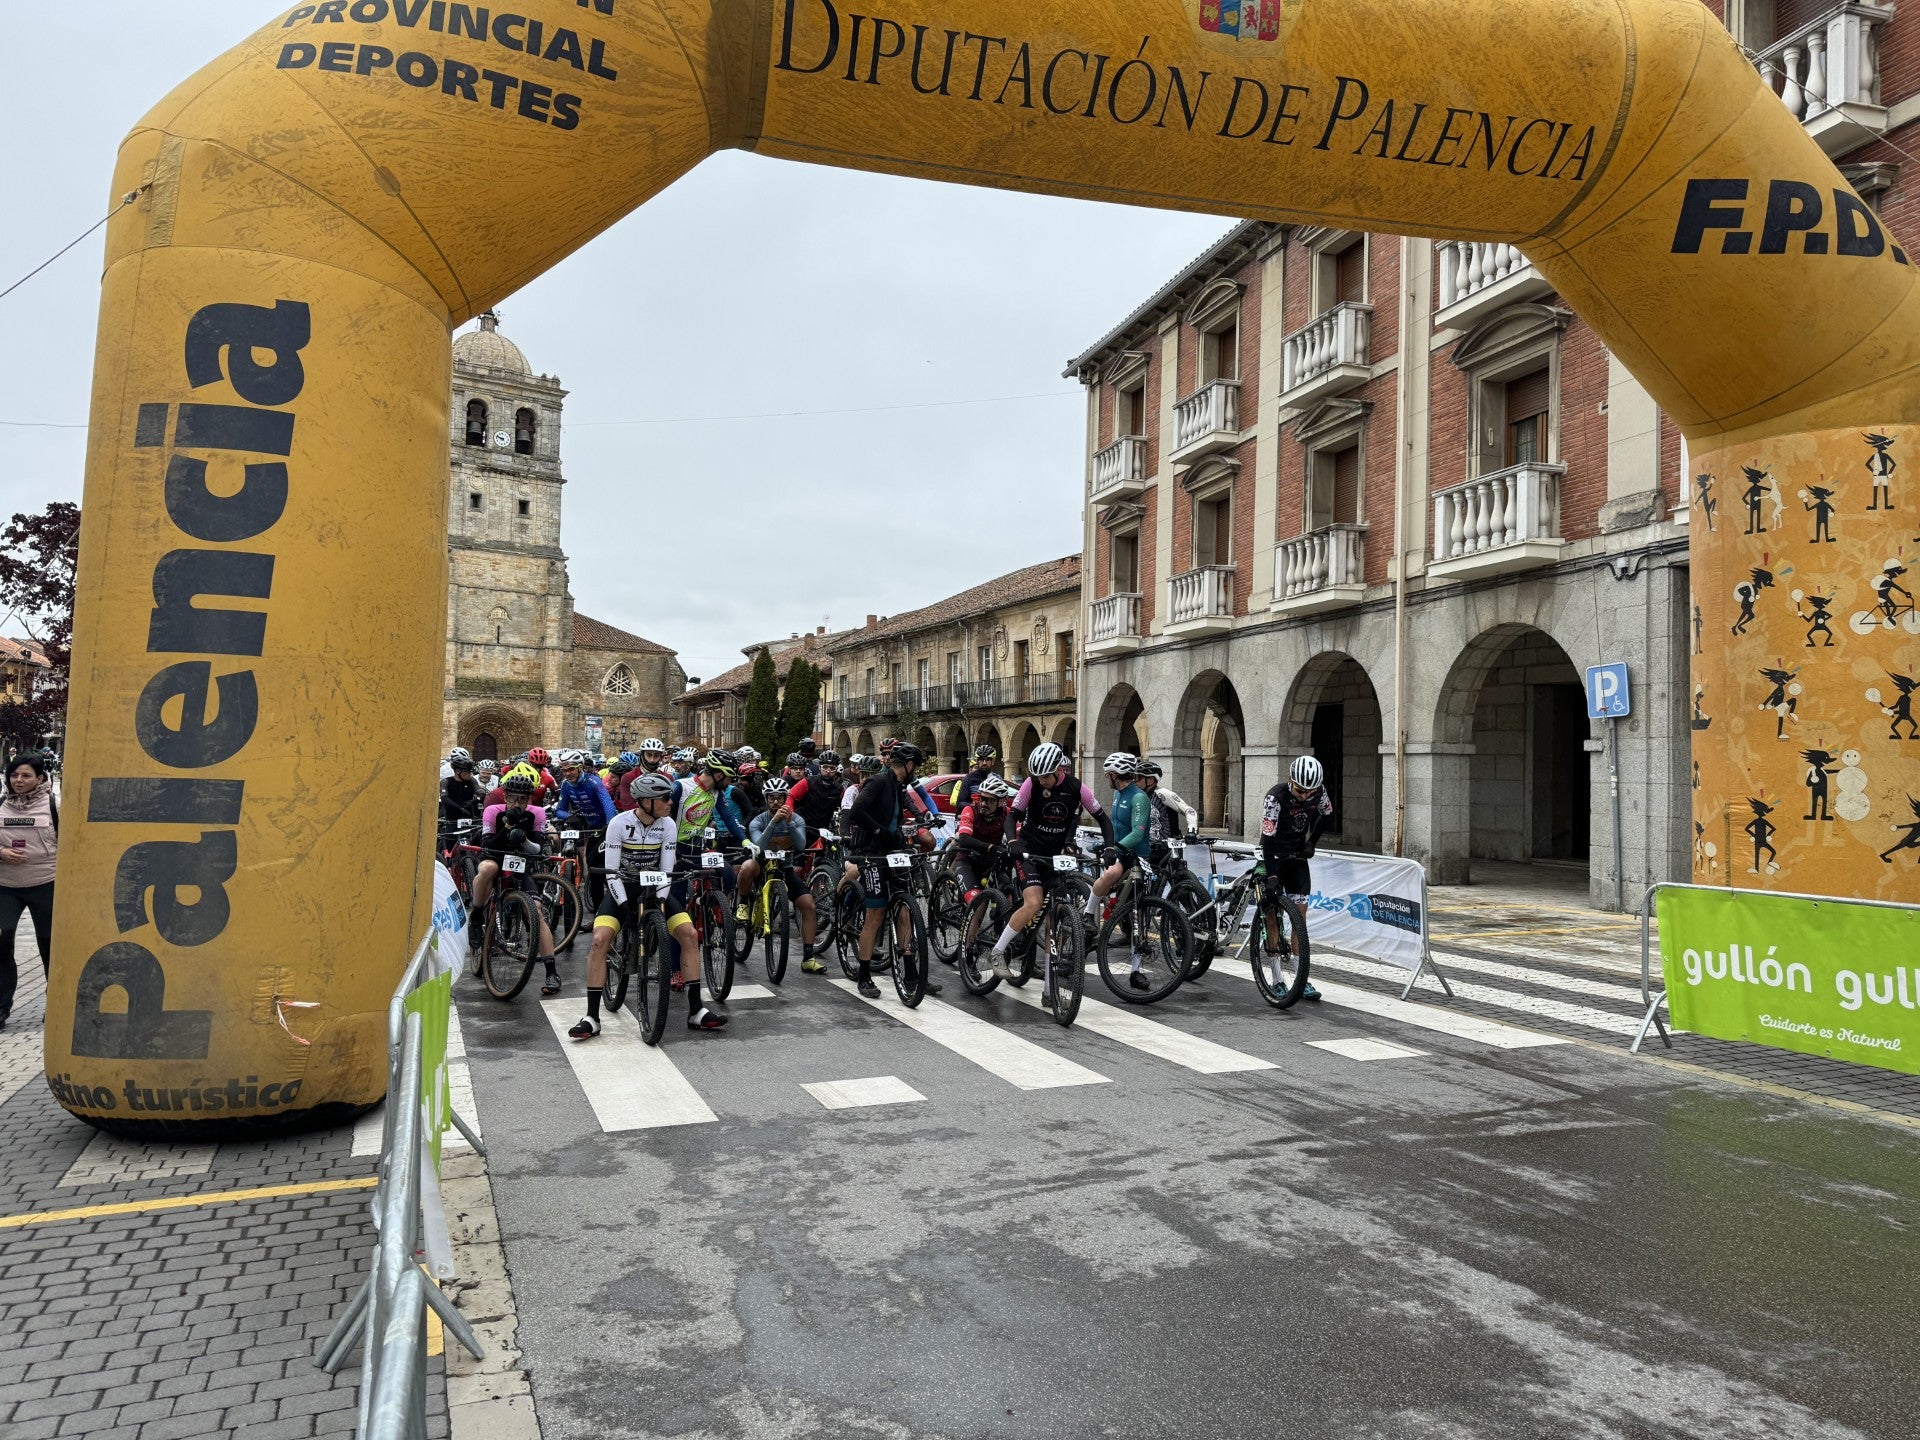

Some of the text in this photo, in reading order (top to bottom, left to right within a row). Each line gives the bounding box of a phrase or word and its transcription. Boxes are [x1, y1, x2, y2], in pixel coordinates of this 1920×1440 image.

[281, 0, 617, 81] PROVINCIAL
[276, 42, 582, 131] DEPORTES
[774, 0, 1597, 182] DIPUTACIÓN DE PALENCIA
[1670, 178, 1909, 266] F.P.D.
[71, 299, 311, 1060] Palencia
[1594, 671, 1618, 712] P
[508, 861, 521, 870] 67
[644, 875, 663, 883] 186
[871, 866, 881, 895] DELTA
[893, 857, 905, 865] 34
[1059, 860, 1072, 868] 32
[1308, 890, 1345, 912] rtes
[1372, 897, 1411, 914] Diputación
[1372, 908, 1420, 929] DE PALENCIA
[1682, 943, 1812, 993] gullón
[1758, 1013, 1902, 1052] Cuidarte es Natural
[46, 1072, 303, 1111] stino turístico
